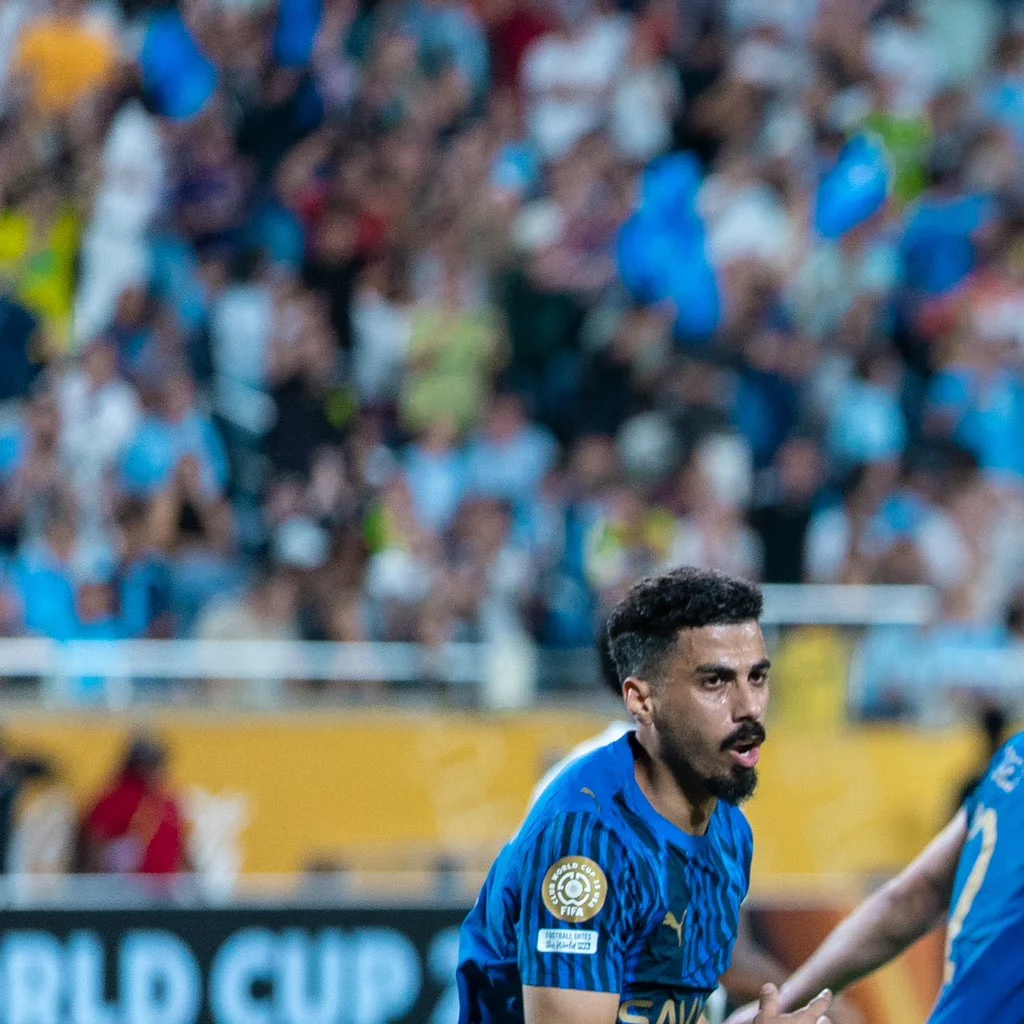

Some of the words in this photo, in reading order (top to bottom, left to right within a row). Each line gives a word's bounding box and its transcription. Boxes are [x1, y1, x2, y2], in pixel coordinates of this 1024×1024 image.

[551, 862, 579, 881] WORLD
[580, 864, 597, 877] CUP
[560, 906, 584, 917] FIFA
